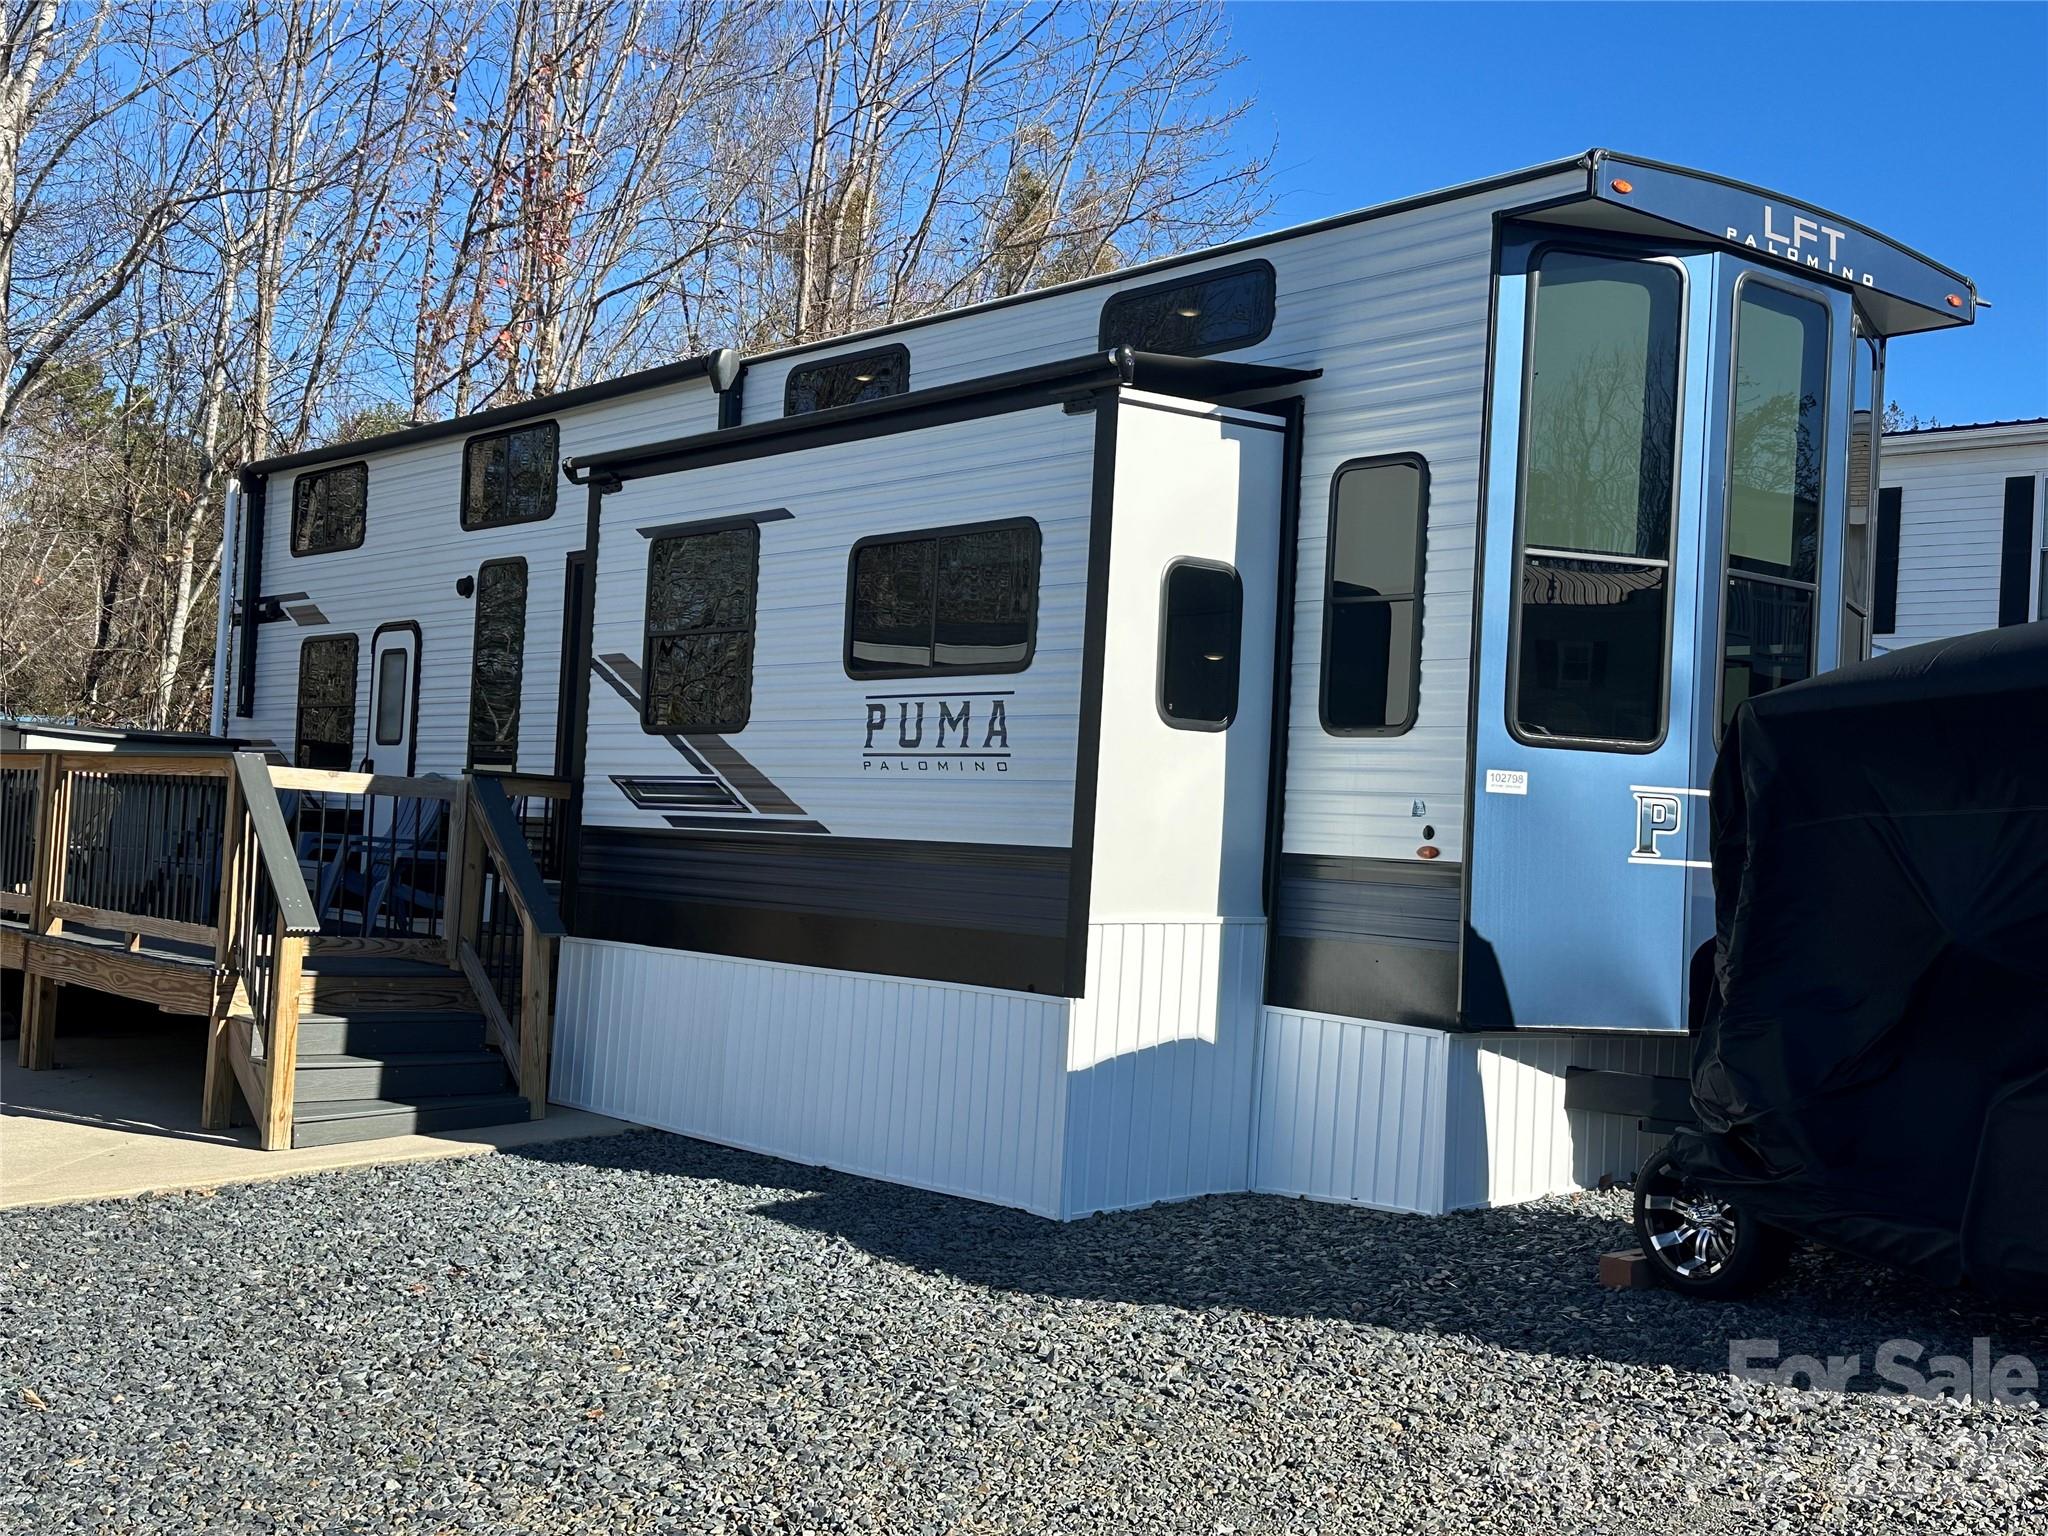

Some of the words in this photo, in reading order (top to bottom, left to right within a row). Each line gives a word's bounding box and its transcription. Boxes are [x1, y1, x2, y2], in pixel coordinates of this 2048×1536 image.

[1726, 226, 1874, 287] PALOMINO
[1763, 205, 1845, 262] LFT
[863, 699, 1010, 749] PUMA
[863, 760, 1008, 772] PALOMINO
[1490, 772, 1524, 784] 102798
